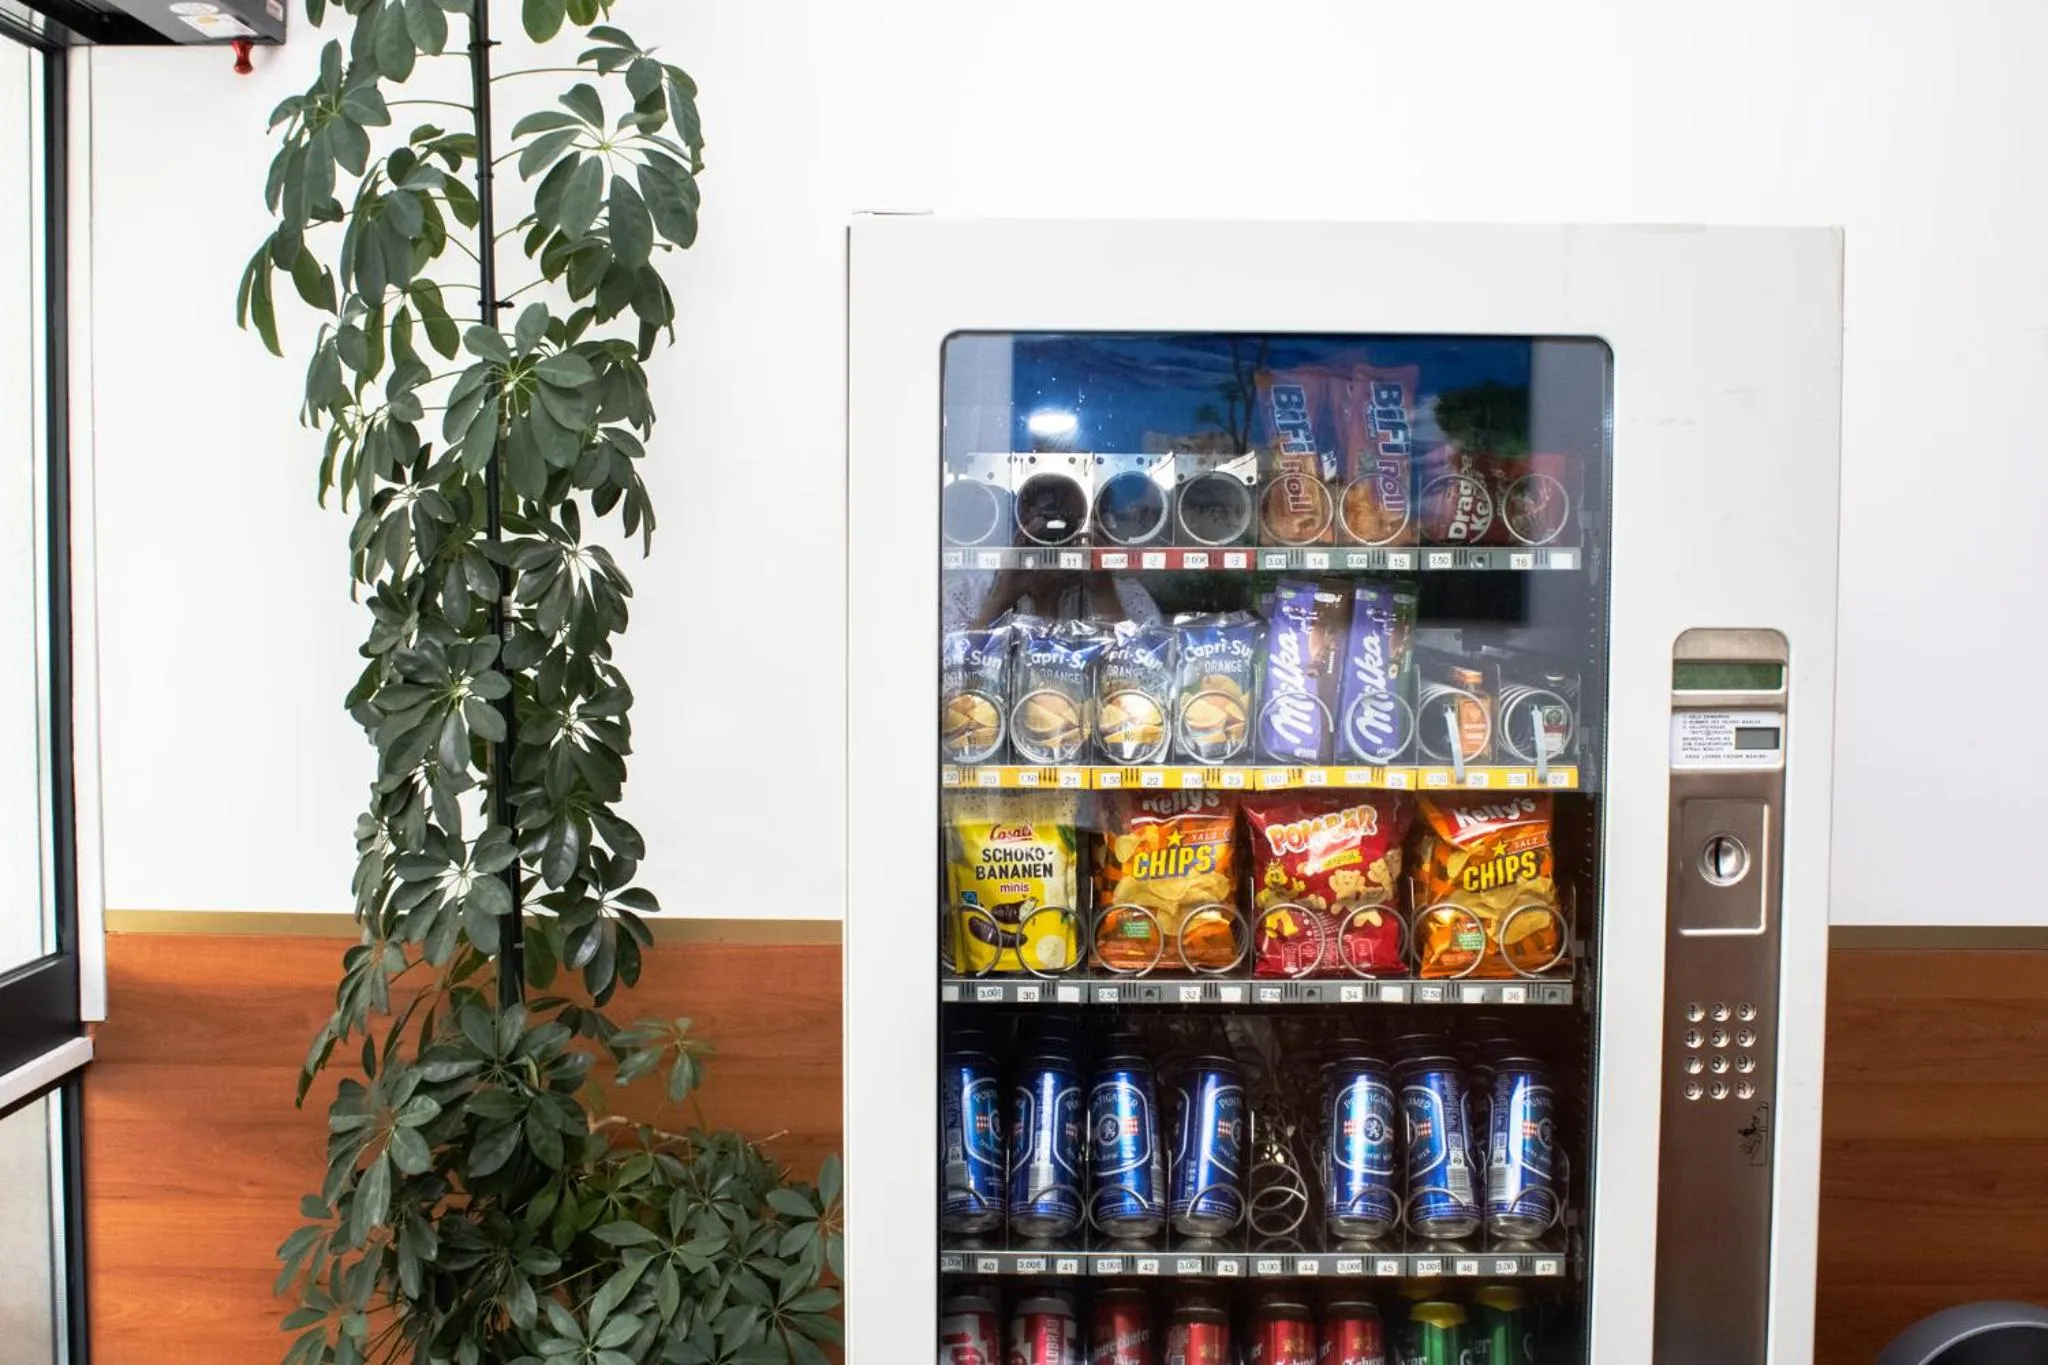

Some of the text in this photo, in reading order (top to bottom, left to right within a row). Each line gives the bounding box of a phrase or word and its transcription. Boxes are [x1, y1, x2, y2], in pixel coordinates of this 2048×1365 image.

[1269, 627, 1315, 745] Milka
[1353, 630, 1395, 745] Milka
[1454, 797, 1537, 830] Kelly's
[975, 863, 1054, 881] BANANEN
[1132, 844, 1213, 879] CHIPS
[1463, 850, 1538, 892] CHIPS
[1000, 882, 1030, 894] minis
